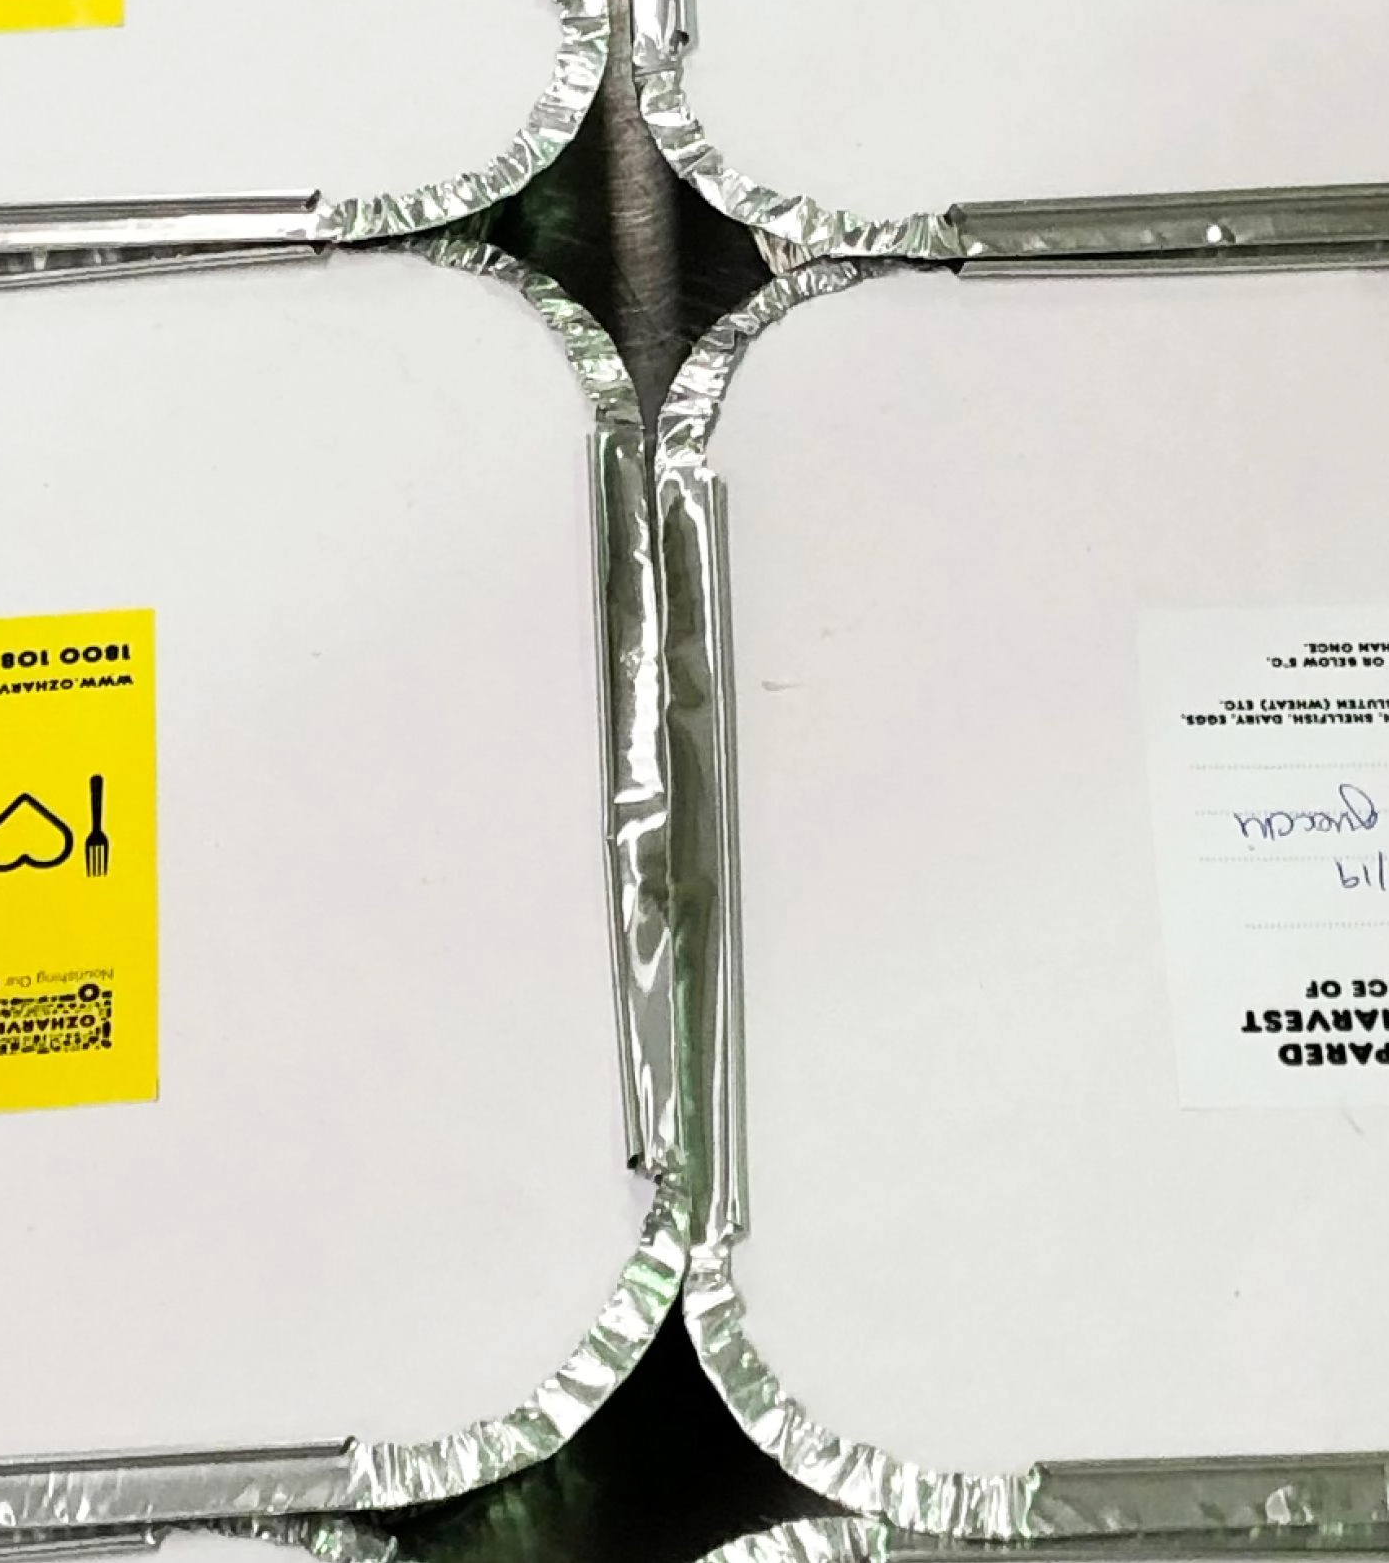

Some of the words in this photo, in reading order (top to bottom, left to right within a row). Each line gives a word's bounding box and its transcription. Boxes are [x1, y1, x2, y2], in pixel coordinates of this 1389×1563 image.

[1, 650, 49, 669] 108
[59, 644, 130, 665] 1800
[5, 975, 32, 988] Our
[36, 968, 114, 986] Nourishing
[1306, 980, 1341, 998] OF
